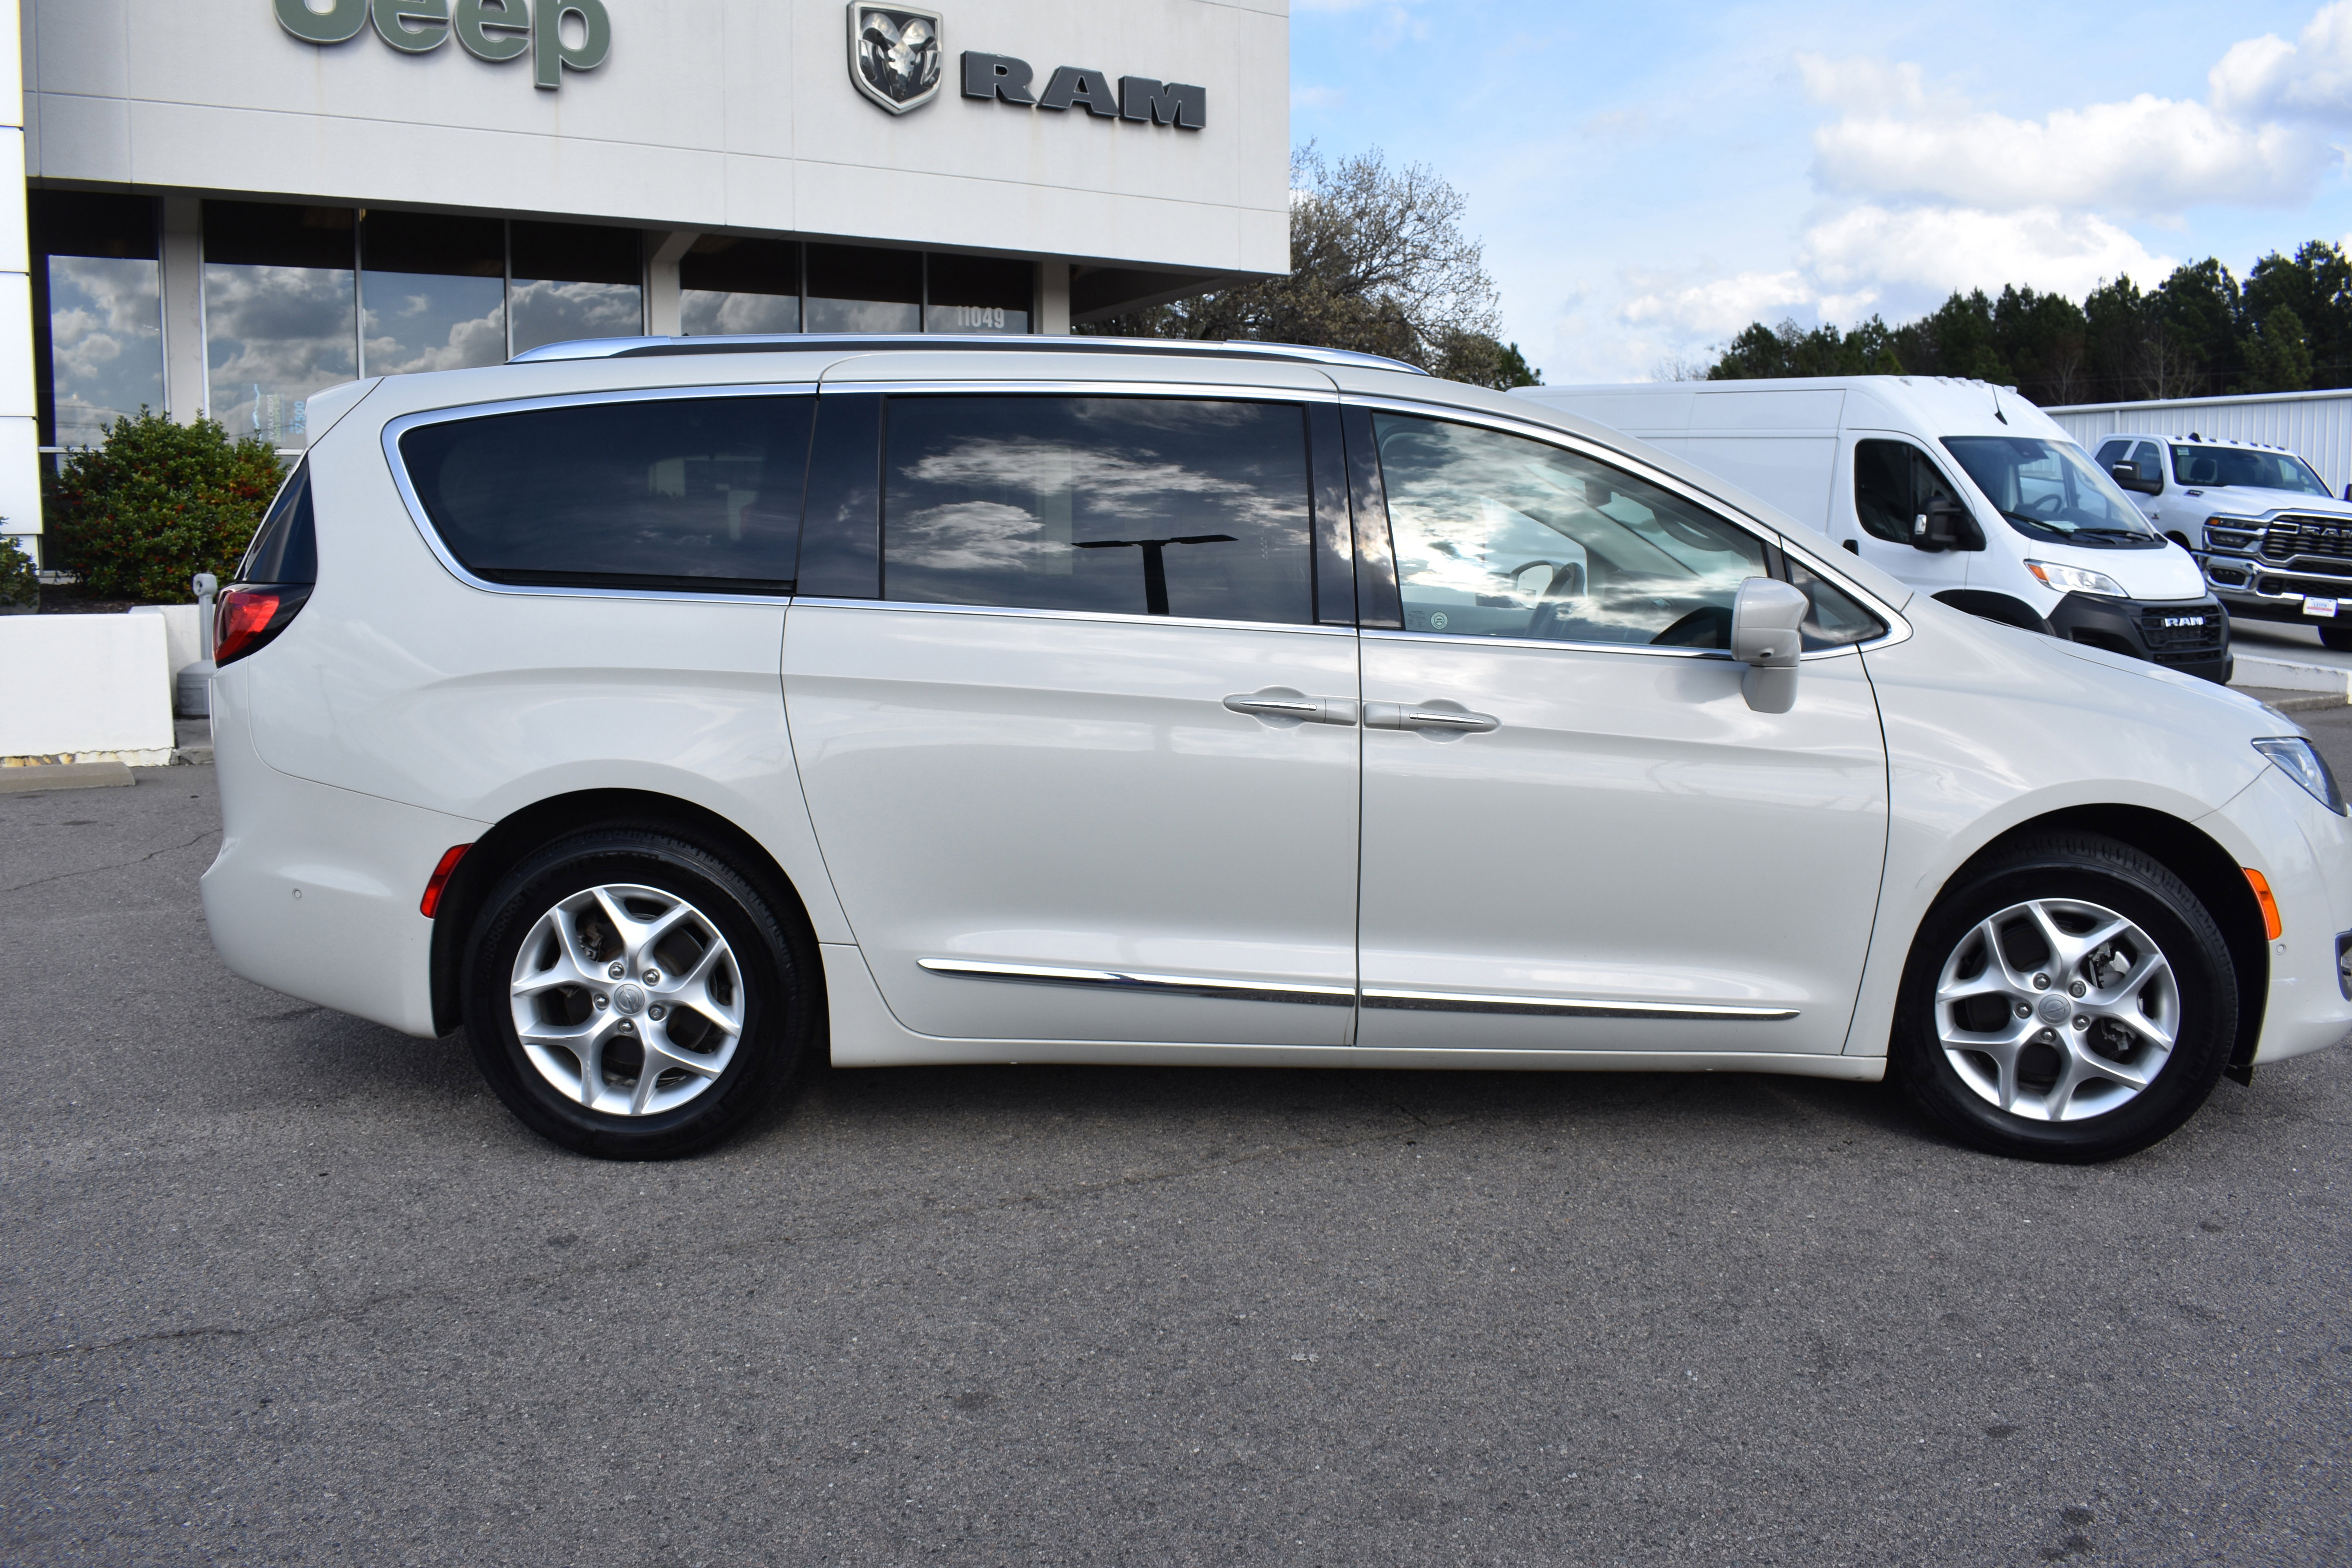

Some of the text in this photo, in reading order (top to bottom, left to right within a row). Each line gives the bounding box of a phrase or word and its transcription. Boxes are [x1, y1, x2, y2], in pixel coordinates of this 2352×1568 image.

[960, 50, 1206, 130] RAM
[957, 305, 1004, 328] 11049
[294, 401, 306, 434] $7,500
[2165, 617, 2204, 627] RAM
